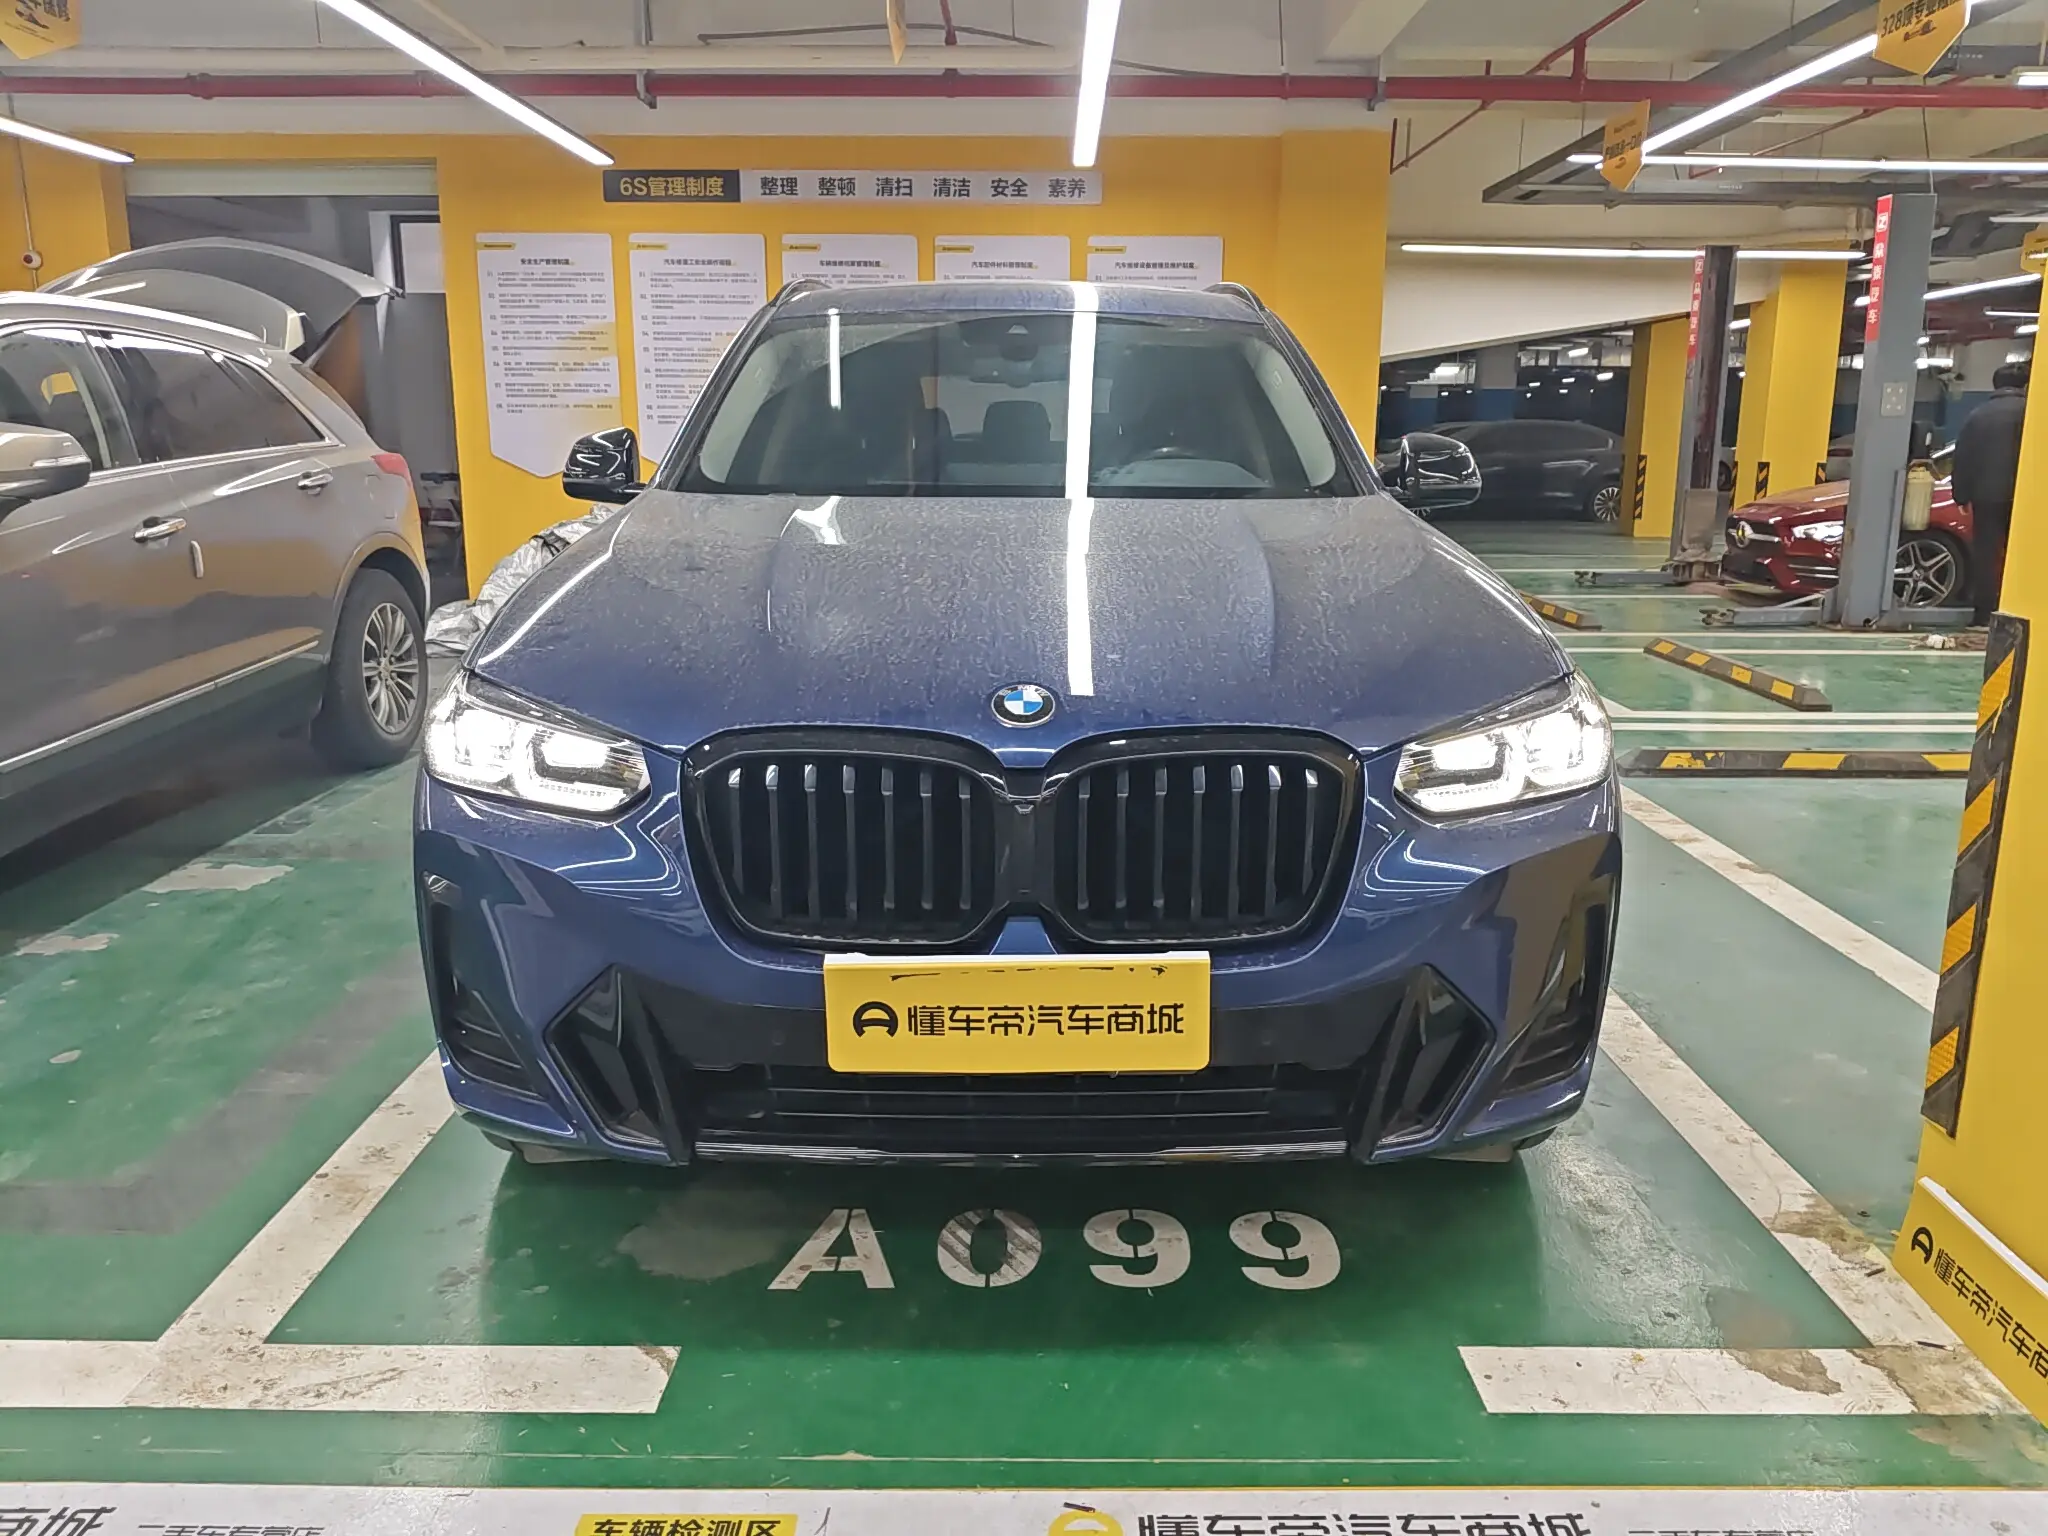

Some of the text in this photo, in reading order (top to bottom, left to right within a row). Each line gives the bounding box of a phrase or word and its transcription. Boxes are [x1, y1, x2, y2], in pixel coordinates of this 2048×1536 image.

[619, 176, 725, 198] 6S管理制度
[760, 177, 1087, 198] 整理 整顿 清扫 清洁 安全 素养
[907, 1002, 1185, 1037] 懂车帝汽车商城
[767, 1208, 1341, 1290] A099
